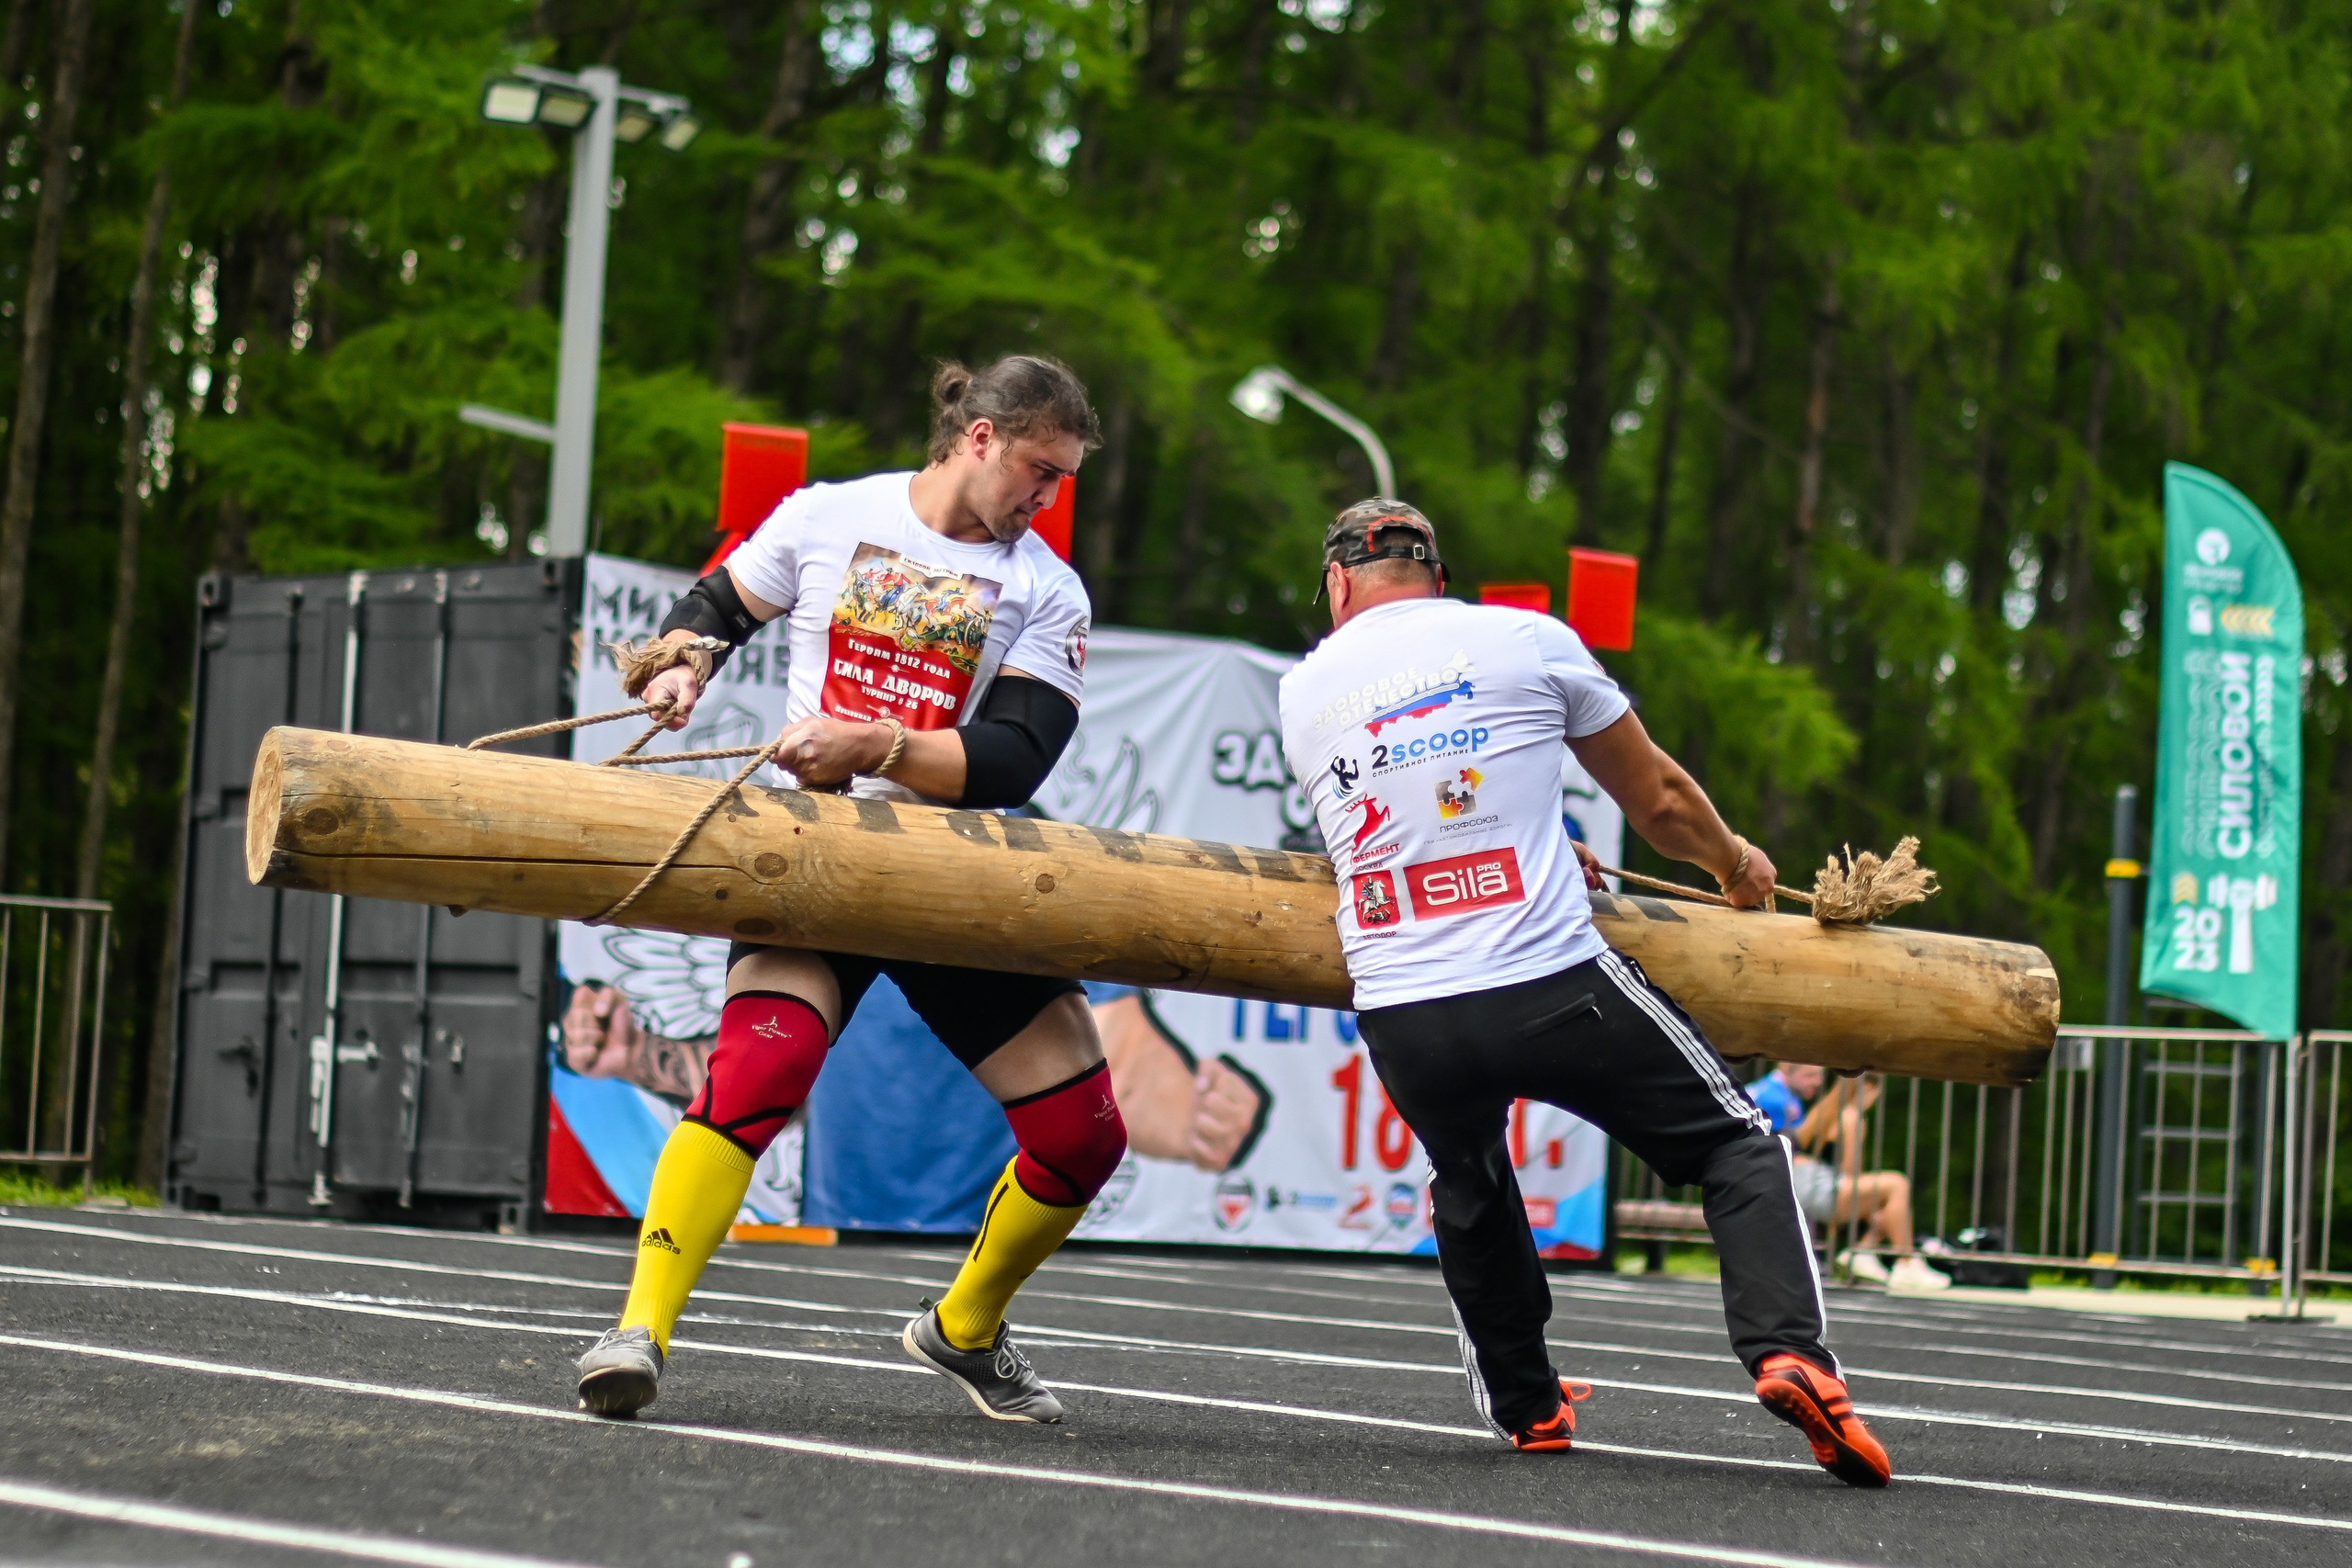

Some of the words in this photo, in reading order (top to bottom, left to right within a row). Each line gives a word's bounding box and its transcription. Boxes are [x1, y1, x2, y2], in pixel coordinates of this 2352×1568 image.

[895, 652, 921, 669] 1812
[833, 658, 875, 685] СИЛА
[881, 674, 956, 710] ДВОРОВ
[861, 685, 897, 704] ТУРНИР
[905, 699, 919, 710] 26
[1339, 668, 1459, 727] ОТЕЧЕСТВО
[1371, 727, 1489, 770] 2scoop
[1372, 757, 1427, 778] СПОРТИВНОЕ
[1430, 748, 1469, 761] ПИТАНИЕ
[1439, 815, 1498, 833] ПРОФСОЮЗ
[1352, 842, 1400, 863] ФЕРМЕНТ
[1476, 862, 1502, 873] PRO
[1423, 866, 1509, 906] Sila
[2173, 908, 2222, 940] 20
[2173, 940, 2220, 972] 23
[641, 1235, 682, 1255] adidas
